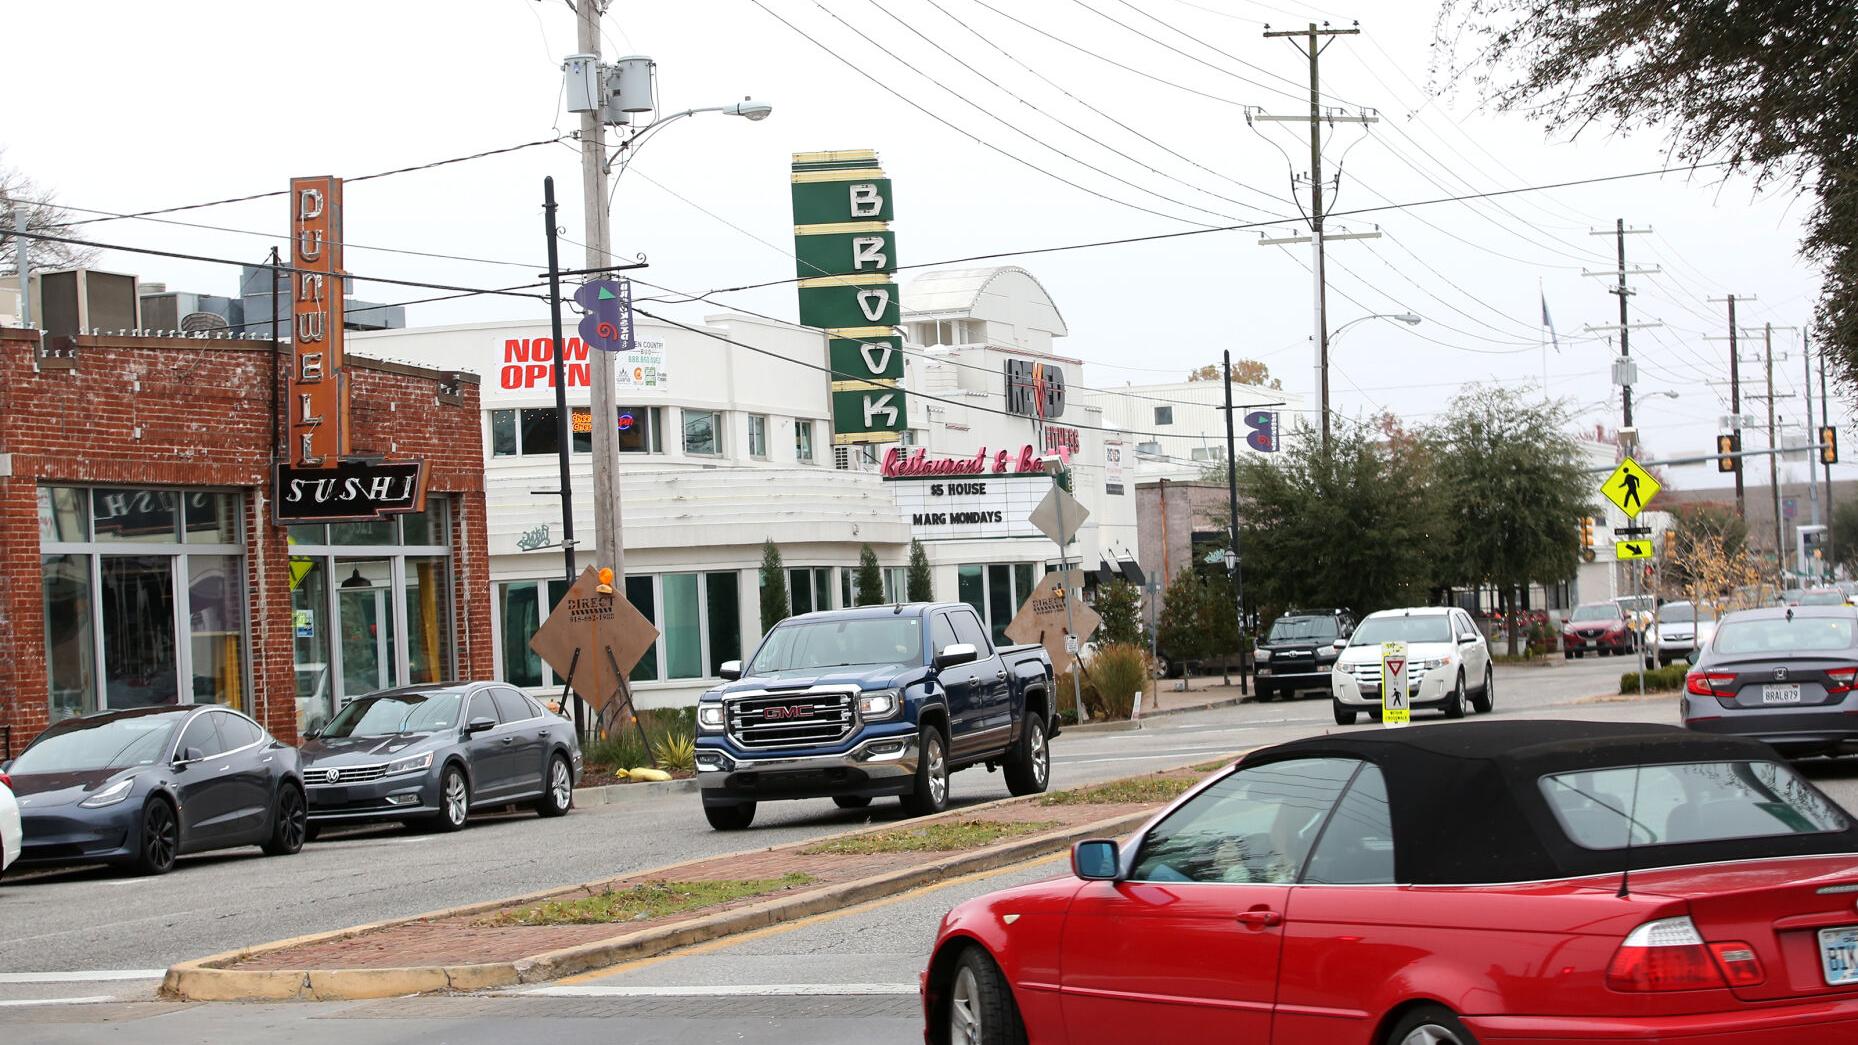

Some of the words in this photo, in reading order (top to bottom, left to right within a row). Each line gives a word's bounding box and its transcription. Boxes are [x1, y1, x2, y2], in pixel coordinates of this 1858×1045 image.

[850, 183, 898, 428] BROOK
[298, 188, 327, 465] DUNWELL
[504, 337, 590, 363] NOW
[881, 446, 987, 477] Restaurant
[992, 449, 1009, 474] &
[1016, 444, 1047, 473] Ba
[287, 474, 415, 503] SUSHI
[931, 483, 944, 497] $5
[948, 483, 987, 496] HOUSE
[913, 513, 947, 526] MARG
[950, 511, 1003, 525] MONDAYS
[568, 596, 614, 610] DIRECT
[763, 704, 815, 720] GMC
